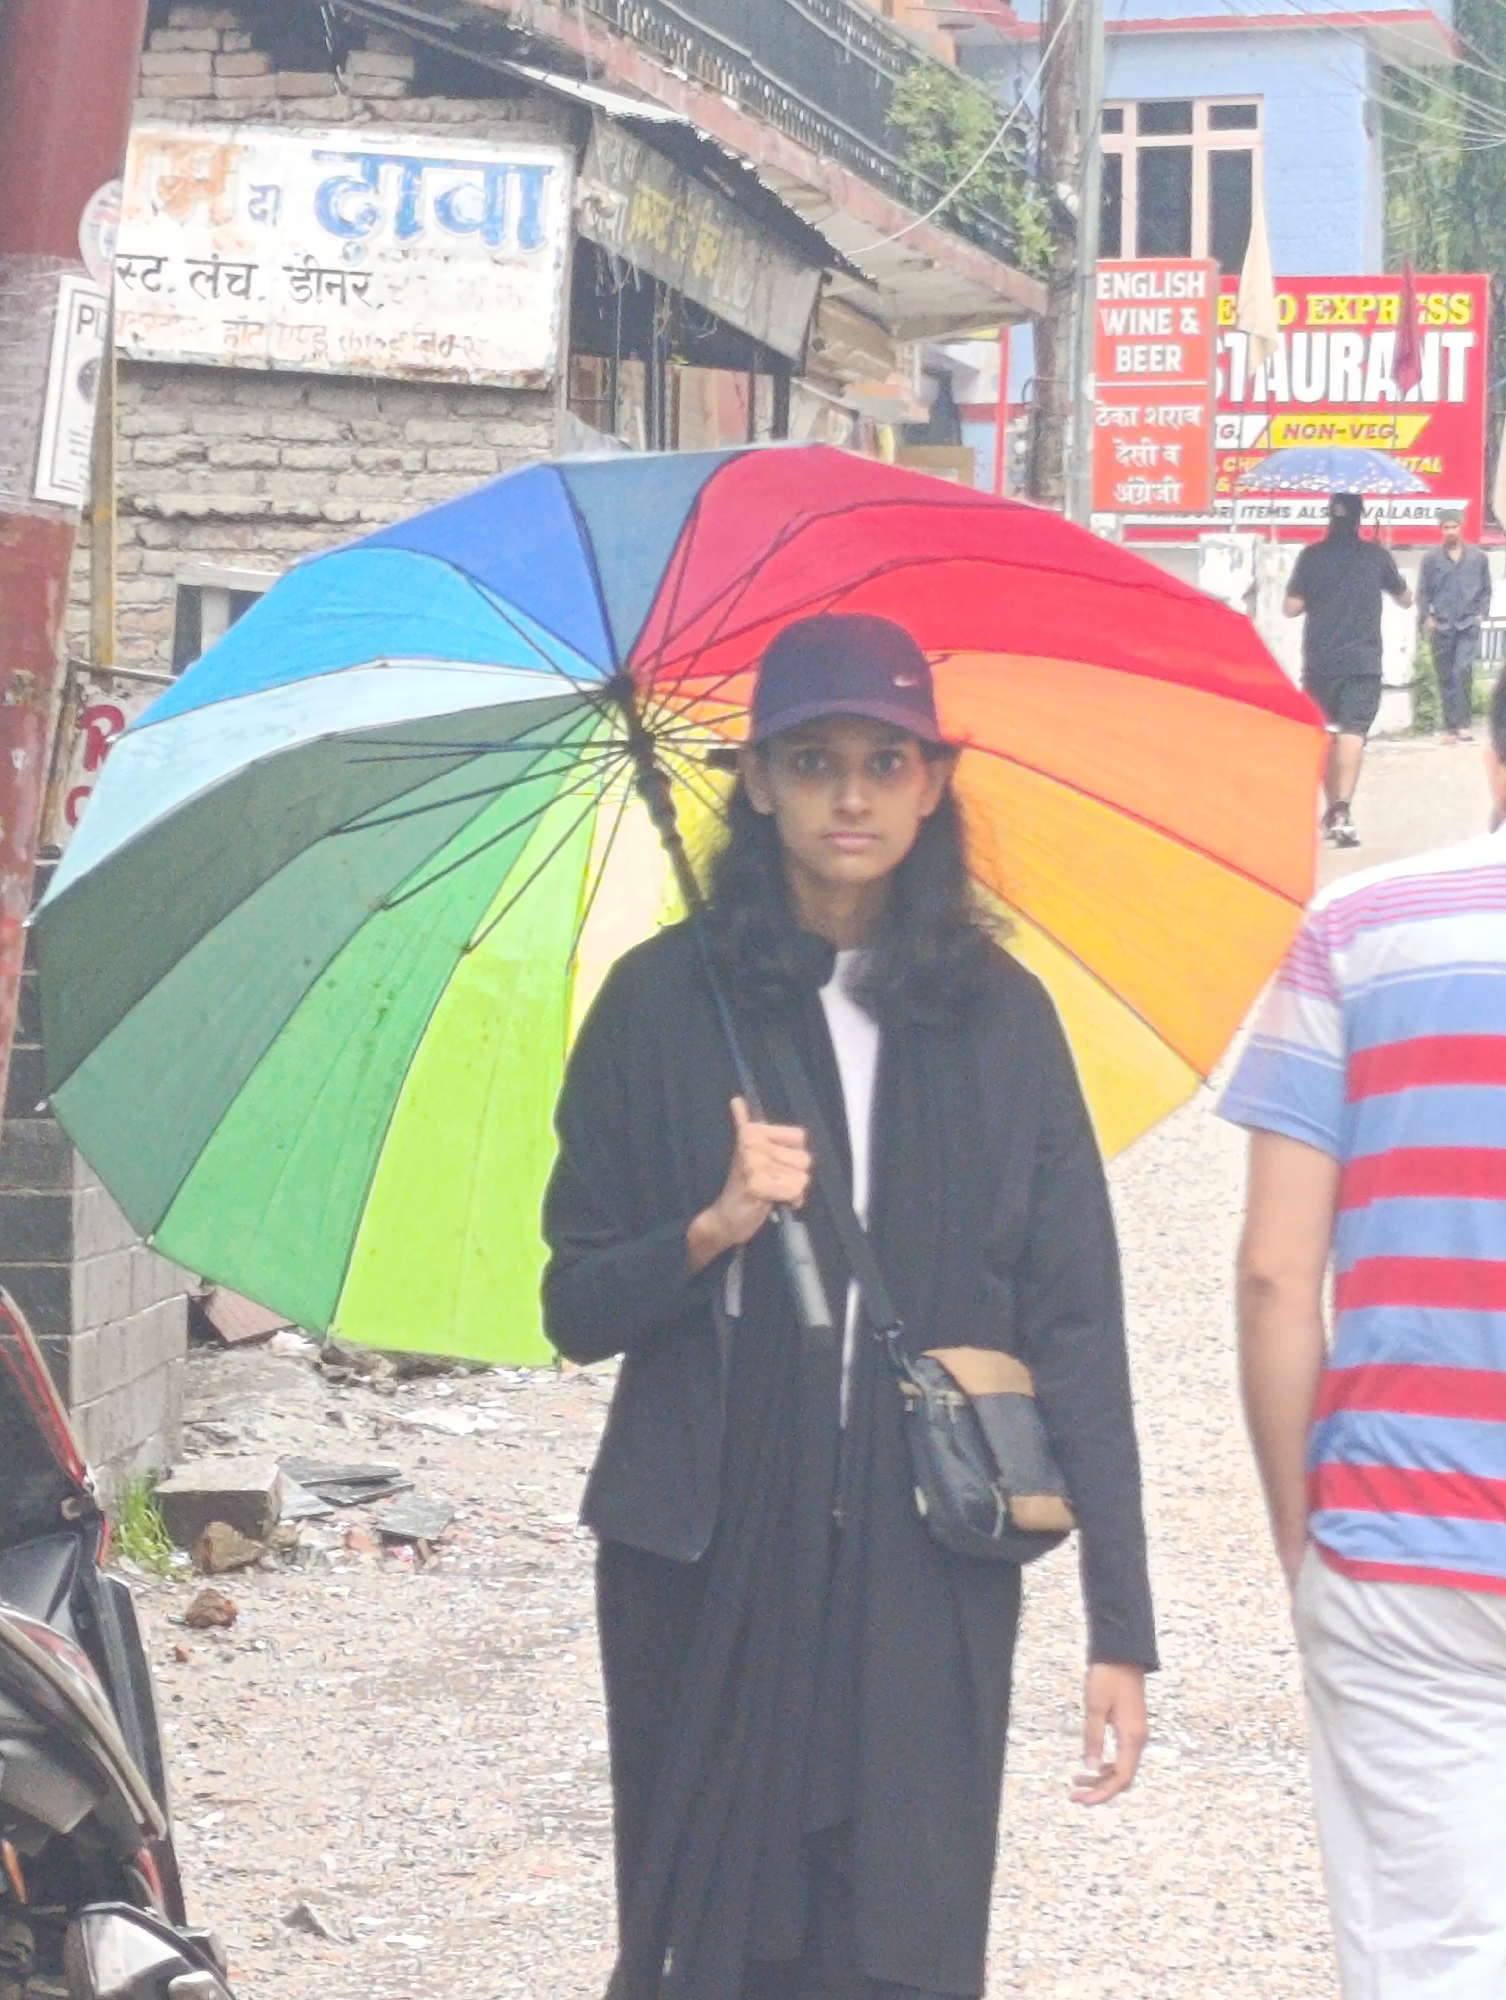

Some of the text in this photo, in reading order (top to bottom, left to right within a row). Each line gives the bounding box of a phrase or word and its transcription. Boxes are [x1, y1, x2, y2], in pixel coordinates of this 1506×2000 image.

[1096, 270, 1206, 299] ENGLISH
[1100, 307, 1202, 336] WINE &
[1306, 293, 1472, 325] EXPRSS
[1116, 345, 1181, 373] BEER
[1297, 506, 1331, 519] ALS
[1360, 506, 1444, 519] VALABL
